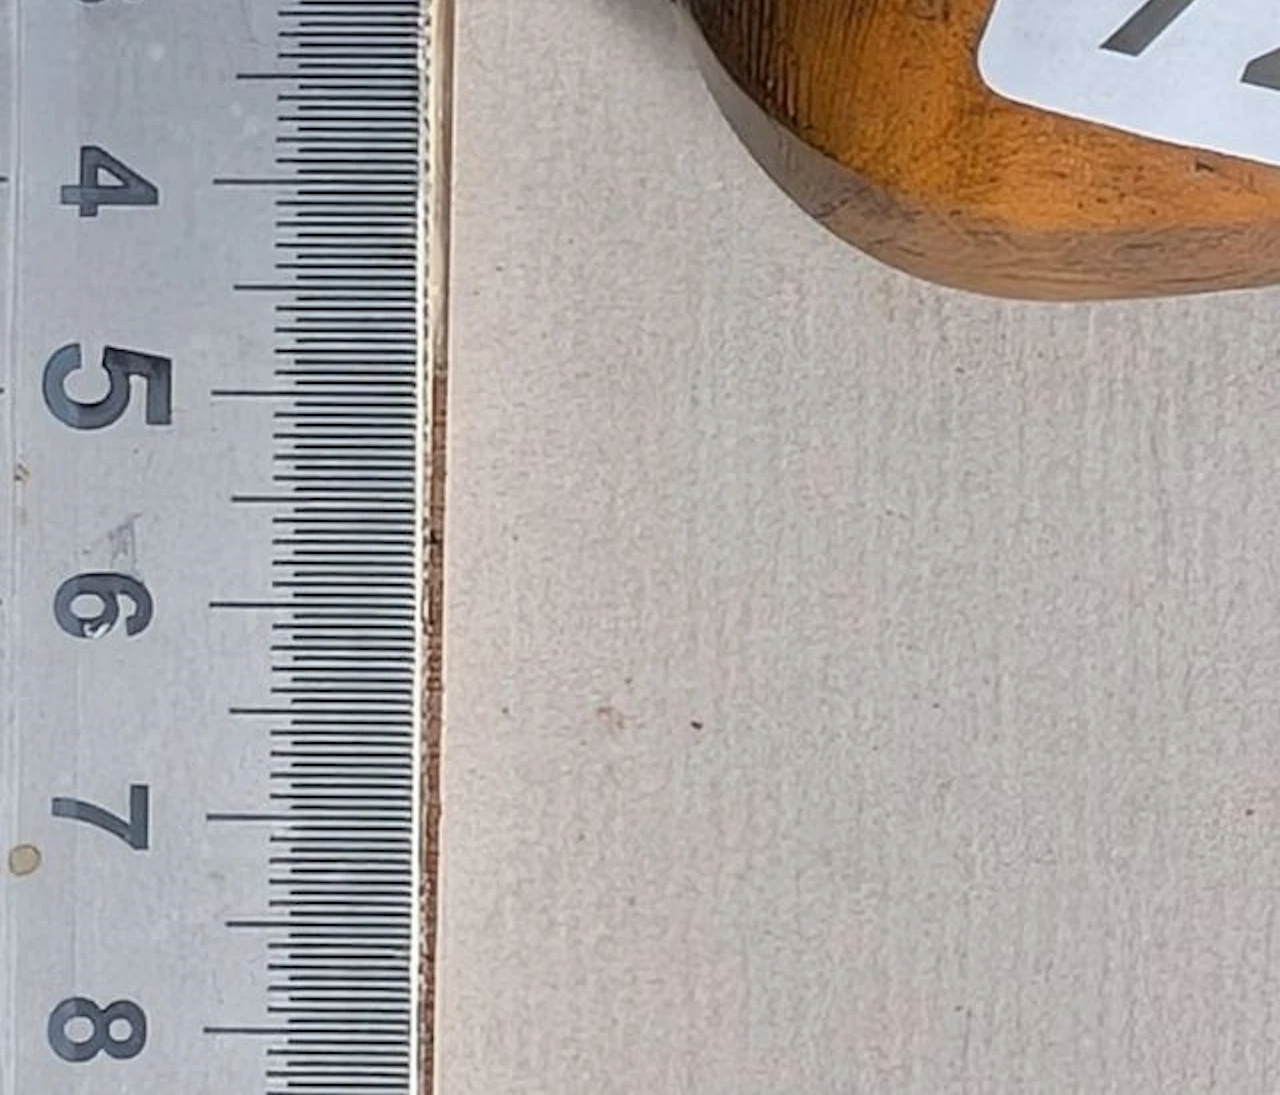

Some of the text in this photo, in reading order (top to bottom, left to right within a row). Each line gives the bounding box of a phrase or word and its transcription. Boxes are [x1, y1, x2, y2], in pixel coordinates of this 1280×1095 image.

[60, 145, 159, 217] 4
[42, 343, 173, 431] 5
[54, 572, 154, 638] 6
[51, 784, 149, 851] 7
[48, 997, 147, 1063] 8
